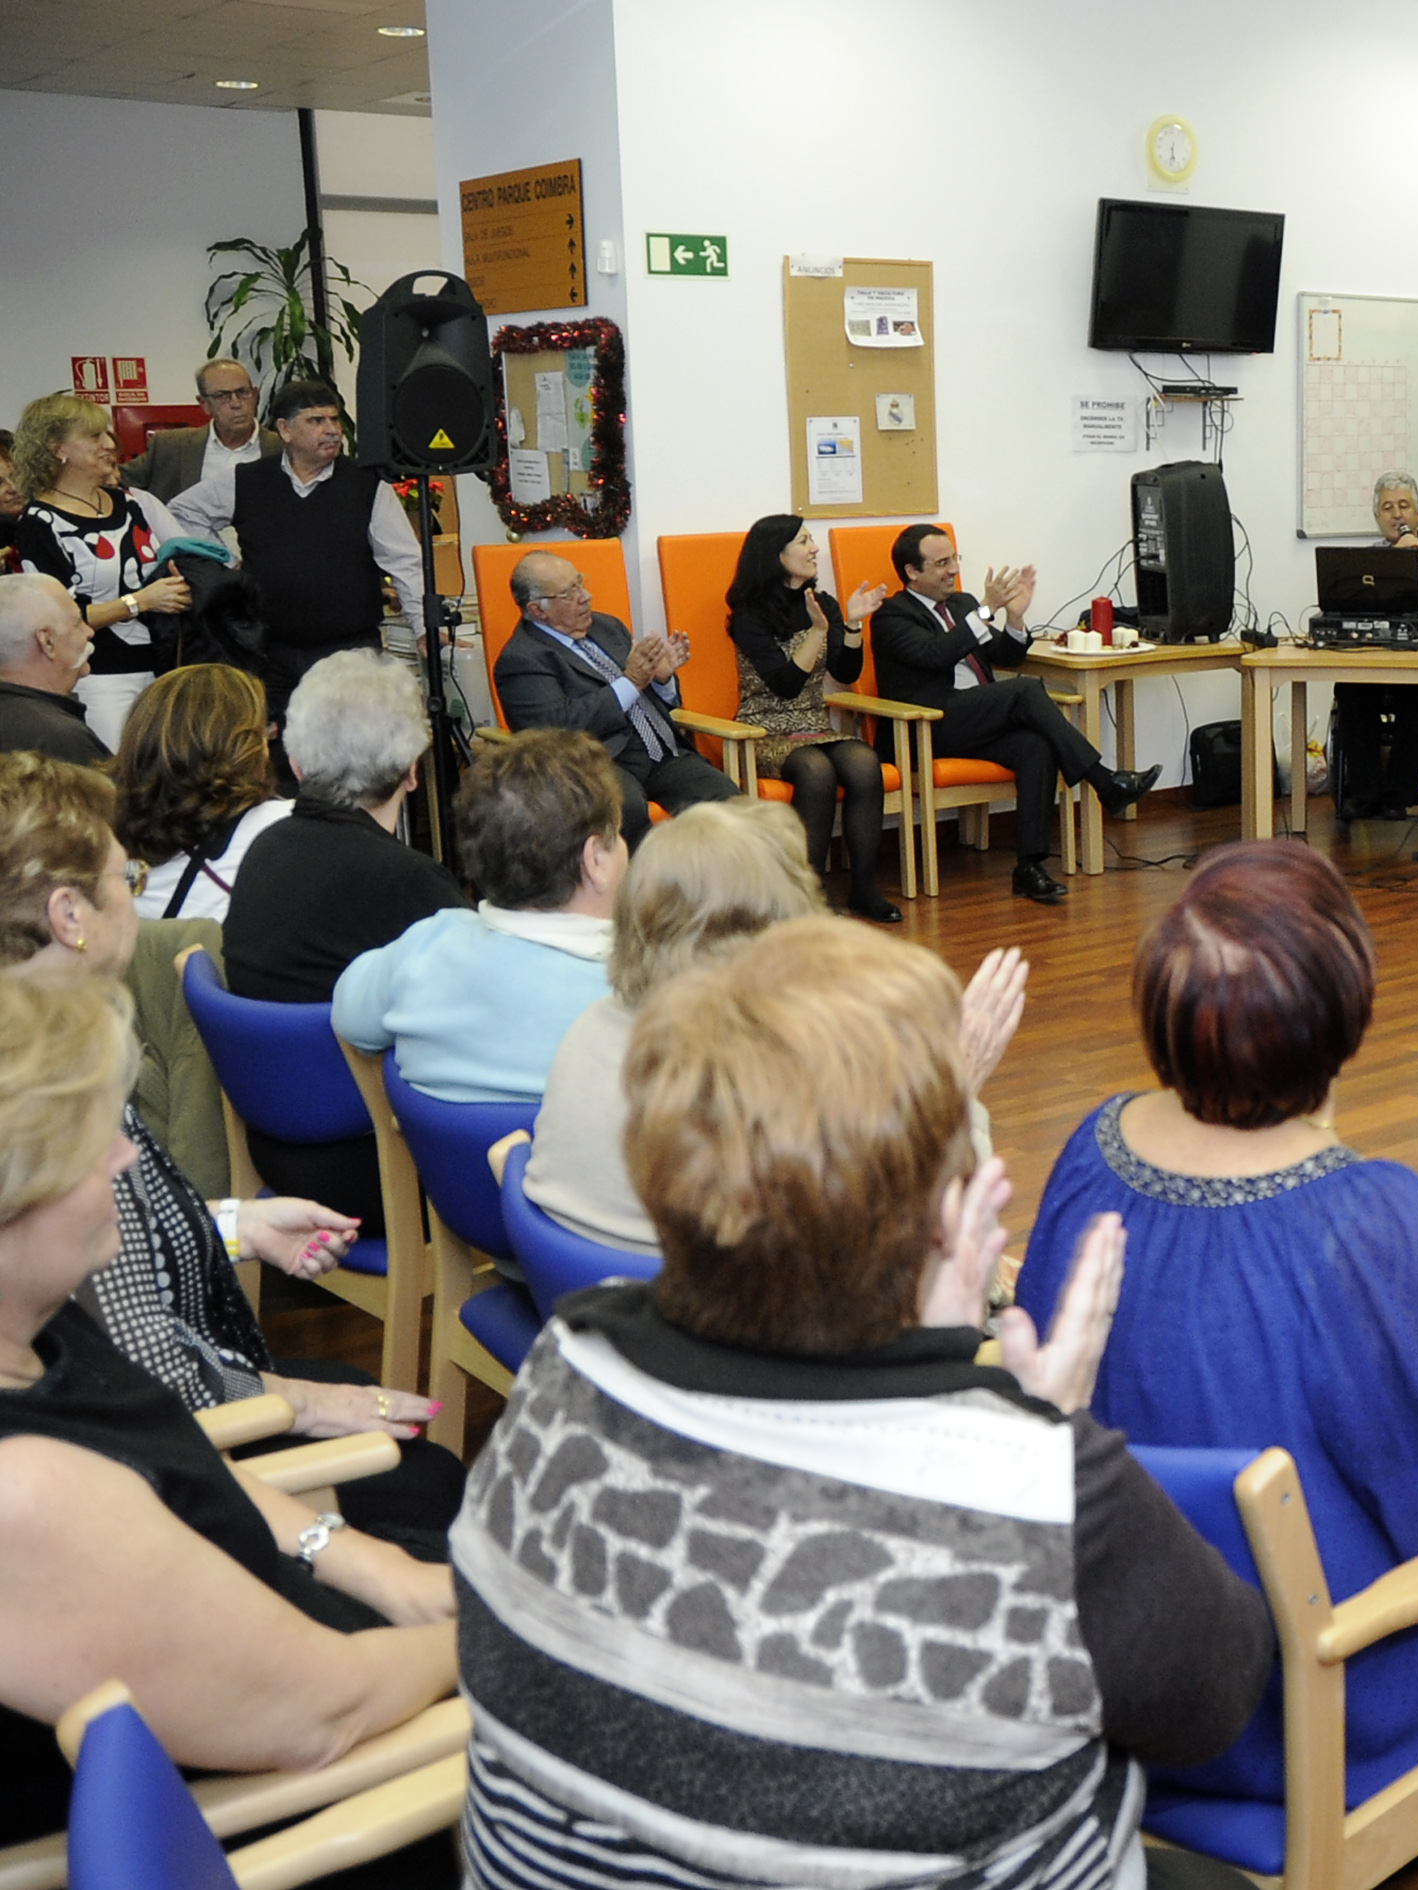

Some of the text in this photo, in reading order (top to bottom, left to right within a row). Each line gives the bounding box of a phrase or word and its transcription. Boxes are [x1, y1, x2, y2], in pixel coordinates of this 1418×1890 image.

[462, 174, 577, 213] CENTRO PARQUE COIMBRA
[797, 265, 835, 275] ANUNCIOS
[1080, 401, 1125, 410] SE PROHIBE
